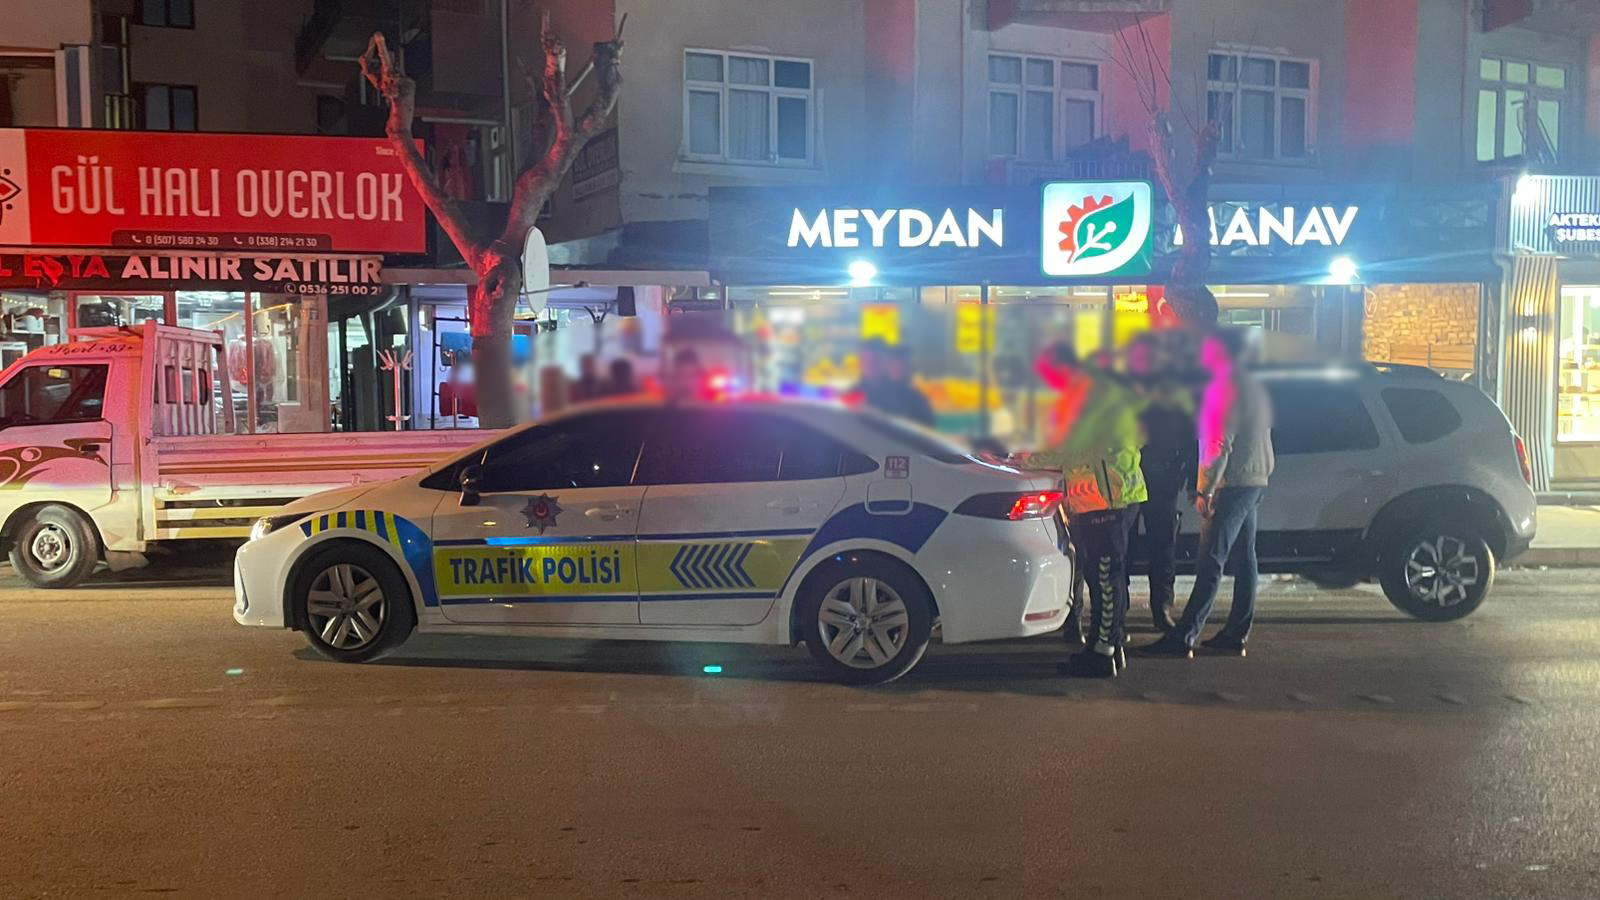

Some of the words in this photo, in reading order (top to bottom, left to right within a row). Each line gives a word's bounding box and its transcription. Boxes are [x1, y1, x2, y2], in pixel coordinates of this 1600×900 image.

[51, 155, 125, 215] GÜL
[138, 166, 220, 217] HALI
[236, 169, 403, 222] OVERLOK
[1549, 213, 1600, 226] AKTEK
[787, 207, 1003, 248] MEYDAN
[154, 235, 175, 245] (507)
[195, 236, 206, 245] 24
[207, 236, 219, 245] 30
[256, 236, 278, 247] (338)
[280, 237, 294, 246] 214
[295, 238, 305, 246] 21
[306, 238, 317, 247] 30
[121, 255, 242, 280] ALINIR
[253, 256, 382, 283] SATILIR
[299, 285, 327, 294] 0536
[331, 285, 349, 295] 251
[352, 285, 368, 295] 00
[888, 458, 906, 469] 112
[449, 551, 536, 585] TRAFİK
[542, 550, 621, 584] POLİSİ
